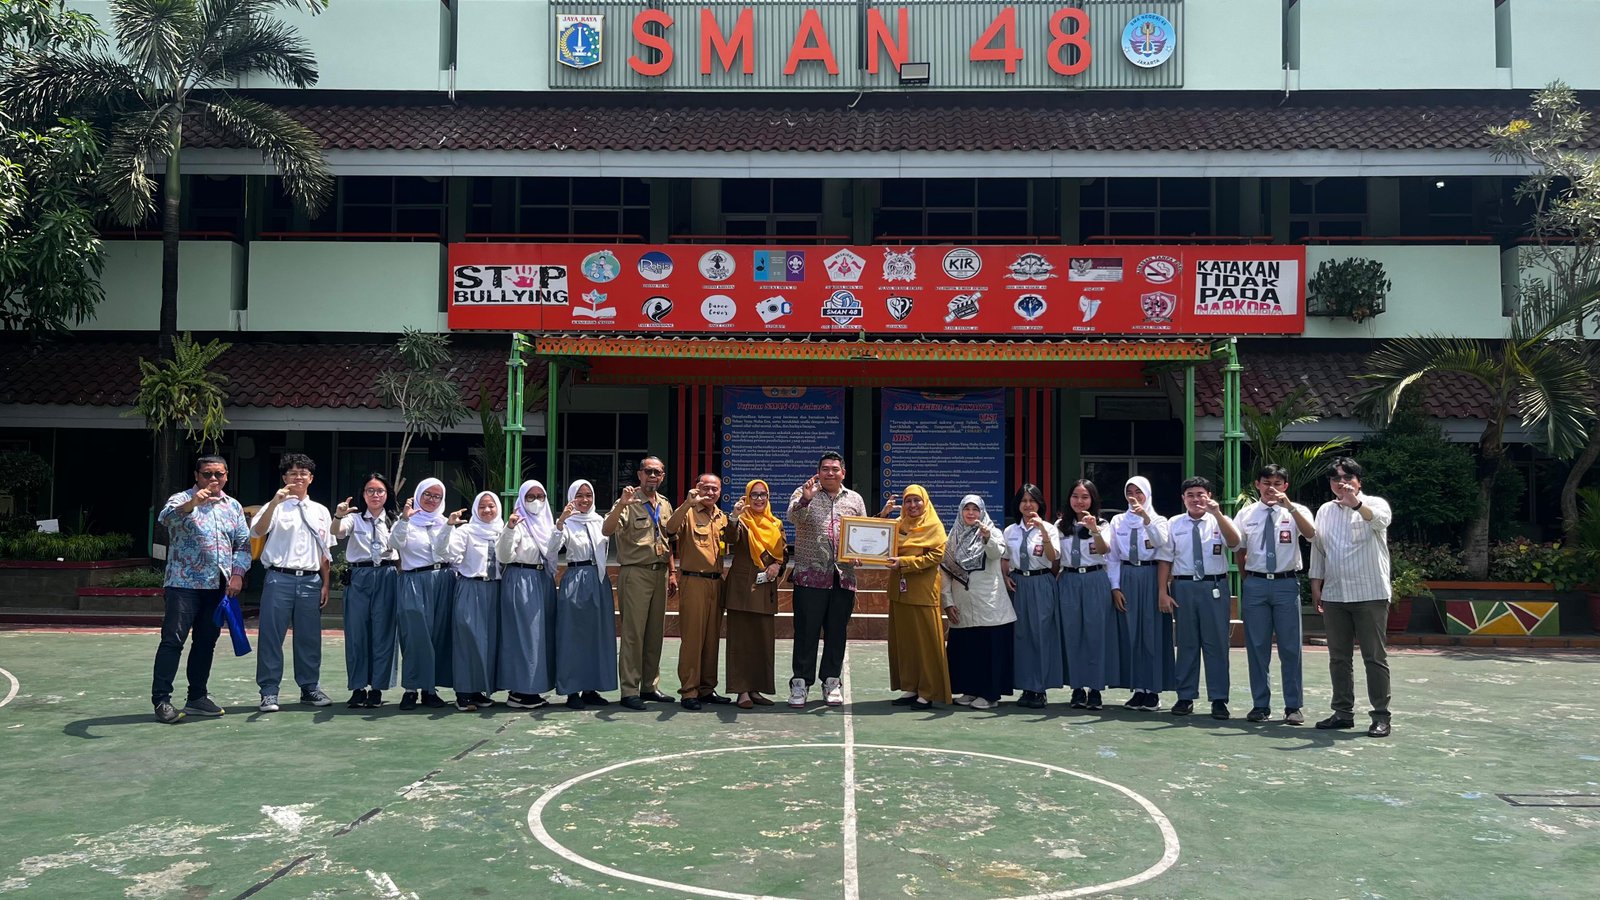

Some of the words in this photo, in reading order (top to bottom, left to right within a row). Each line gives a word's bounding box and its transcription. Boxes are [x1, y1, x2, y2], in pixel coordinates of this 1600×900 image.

[627, 7, 909, 77] SMAN
[969, 7, 1092, 77] 48
[949, 257, 975, 270] KIR
[1197, 261, 1280, 279] KATAKAN
[1197, 271, 1279, 288] TIDAK
[453, 290, 569, 303] BULLYING
[1200, 287, 1280, 304] PADA
[1196, 300, 1284, 315] NARKOBA
